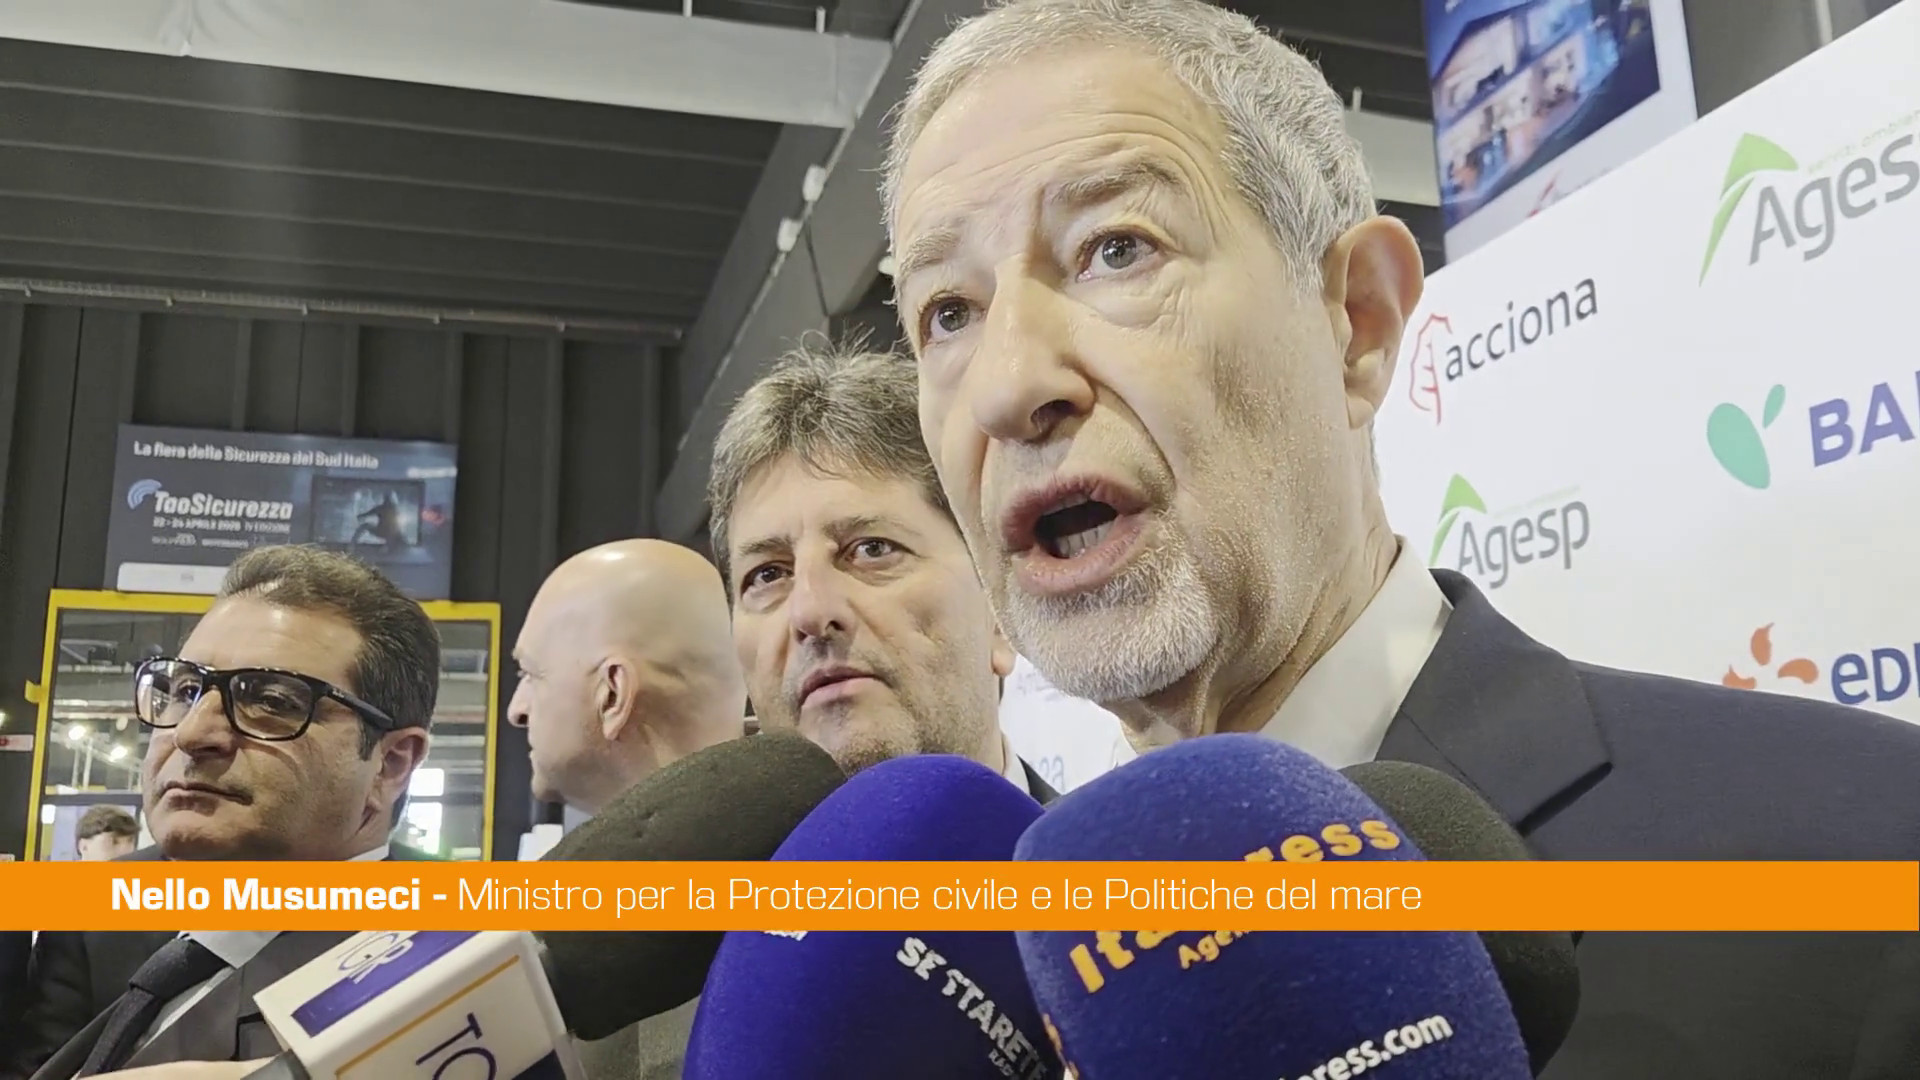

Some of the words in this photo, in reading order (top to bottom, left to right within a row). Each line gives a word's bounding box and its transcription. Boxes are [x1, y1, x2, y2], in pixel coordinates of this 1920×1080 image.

[1748, 133, 1920, 266] Ages
[1445, 278, 1599, 383] acciona
[134, 440, 152, 456] La
[154, 442, 187, 459] fiera
[187, 444, 223, 462] della
[224, 446, 290, 465] Sicurezza
[292, 450, 313, 466] del
[315, 451, 341, 468] Sud
[344, 452, 380, 469] Italia
[1809, 370, 1920, 467] BA
[154, 490, 293, 520] TaoSicurezza
[1458, 500, 1590, 590] Agesp
[1831, 642, 1920, 706] eD
